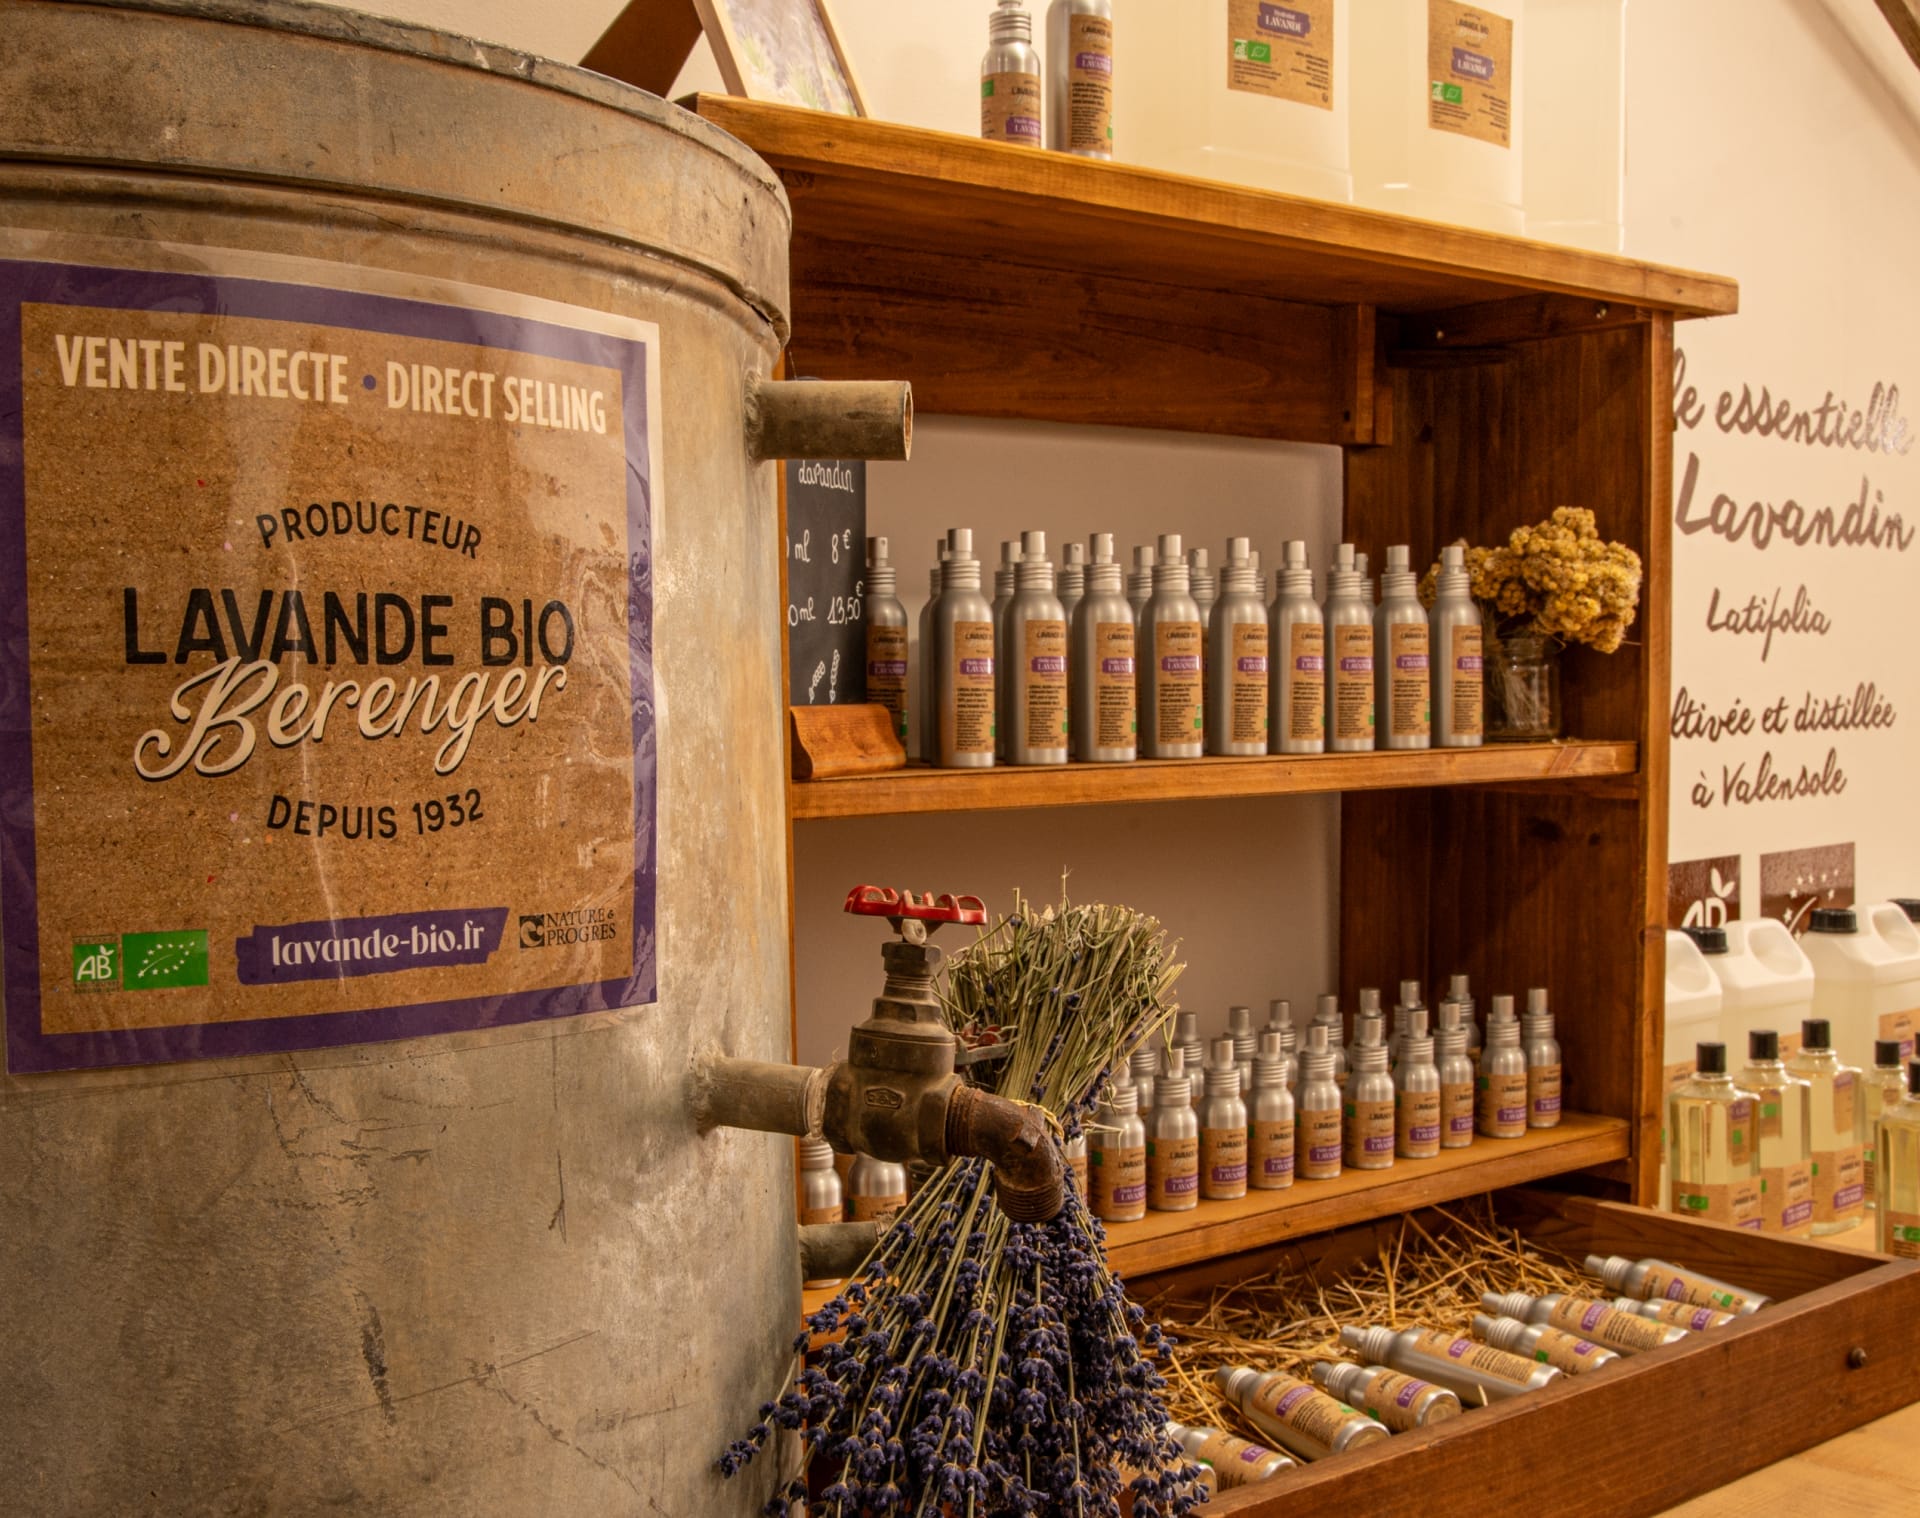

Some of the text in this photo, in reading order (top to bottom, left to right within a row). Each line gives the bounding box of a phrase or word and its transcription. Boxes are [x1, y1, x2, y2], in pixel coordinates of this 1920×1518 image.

[55, 334, 607, 434] VENTE DIRECTE DIRECT SELLING
[1715, 381, 1915, 456] essentielle
[256, 500, 483, 560] PRODUCTEUR
[1675, 452, 1915, 552] Lavandin
[123, 588, 575, 668] LAVANDE BIO
[1707, 584, 1832, 663] Latifolia
[134, 656, 568, 779] Berenger
[1762, 697, 1789, 733] et
[1794, 682, 1897, 732] distillée
[1692, 747, 1848, 808] à Valensole
[266, 789, 484, 839] DEPUIS 1932
[271, 920, 486, 967] lavande-bio.fr
[546, 908, 605, 928] NATURE
[546, 922, 617, 946] PROGRES
[76, 954, 112, 981] AB
